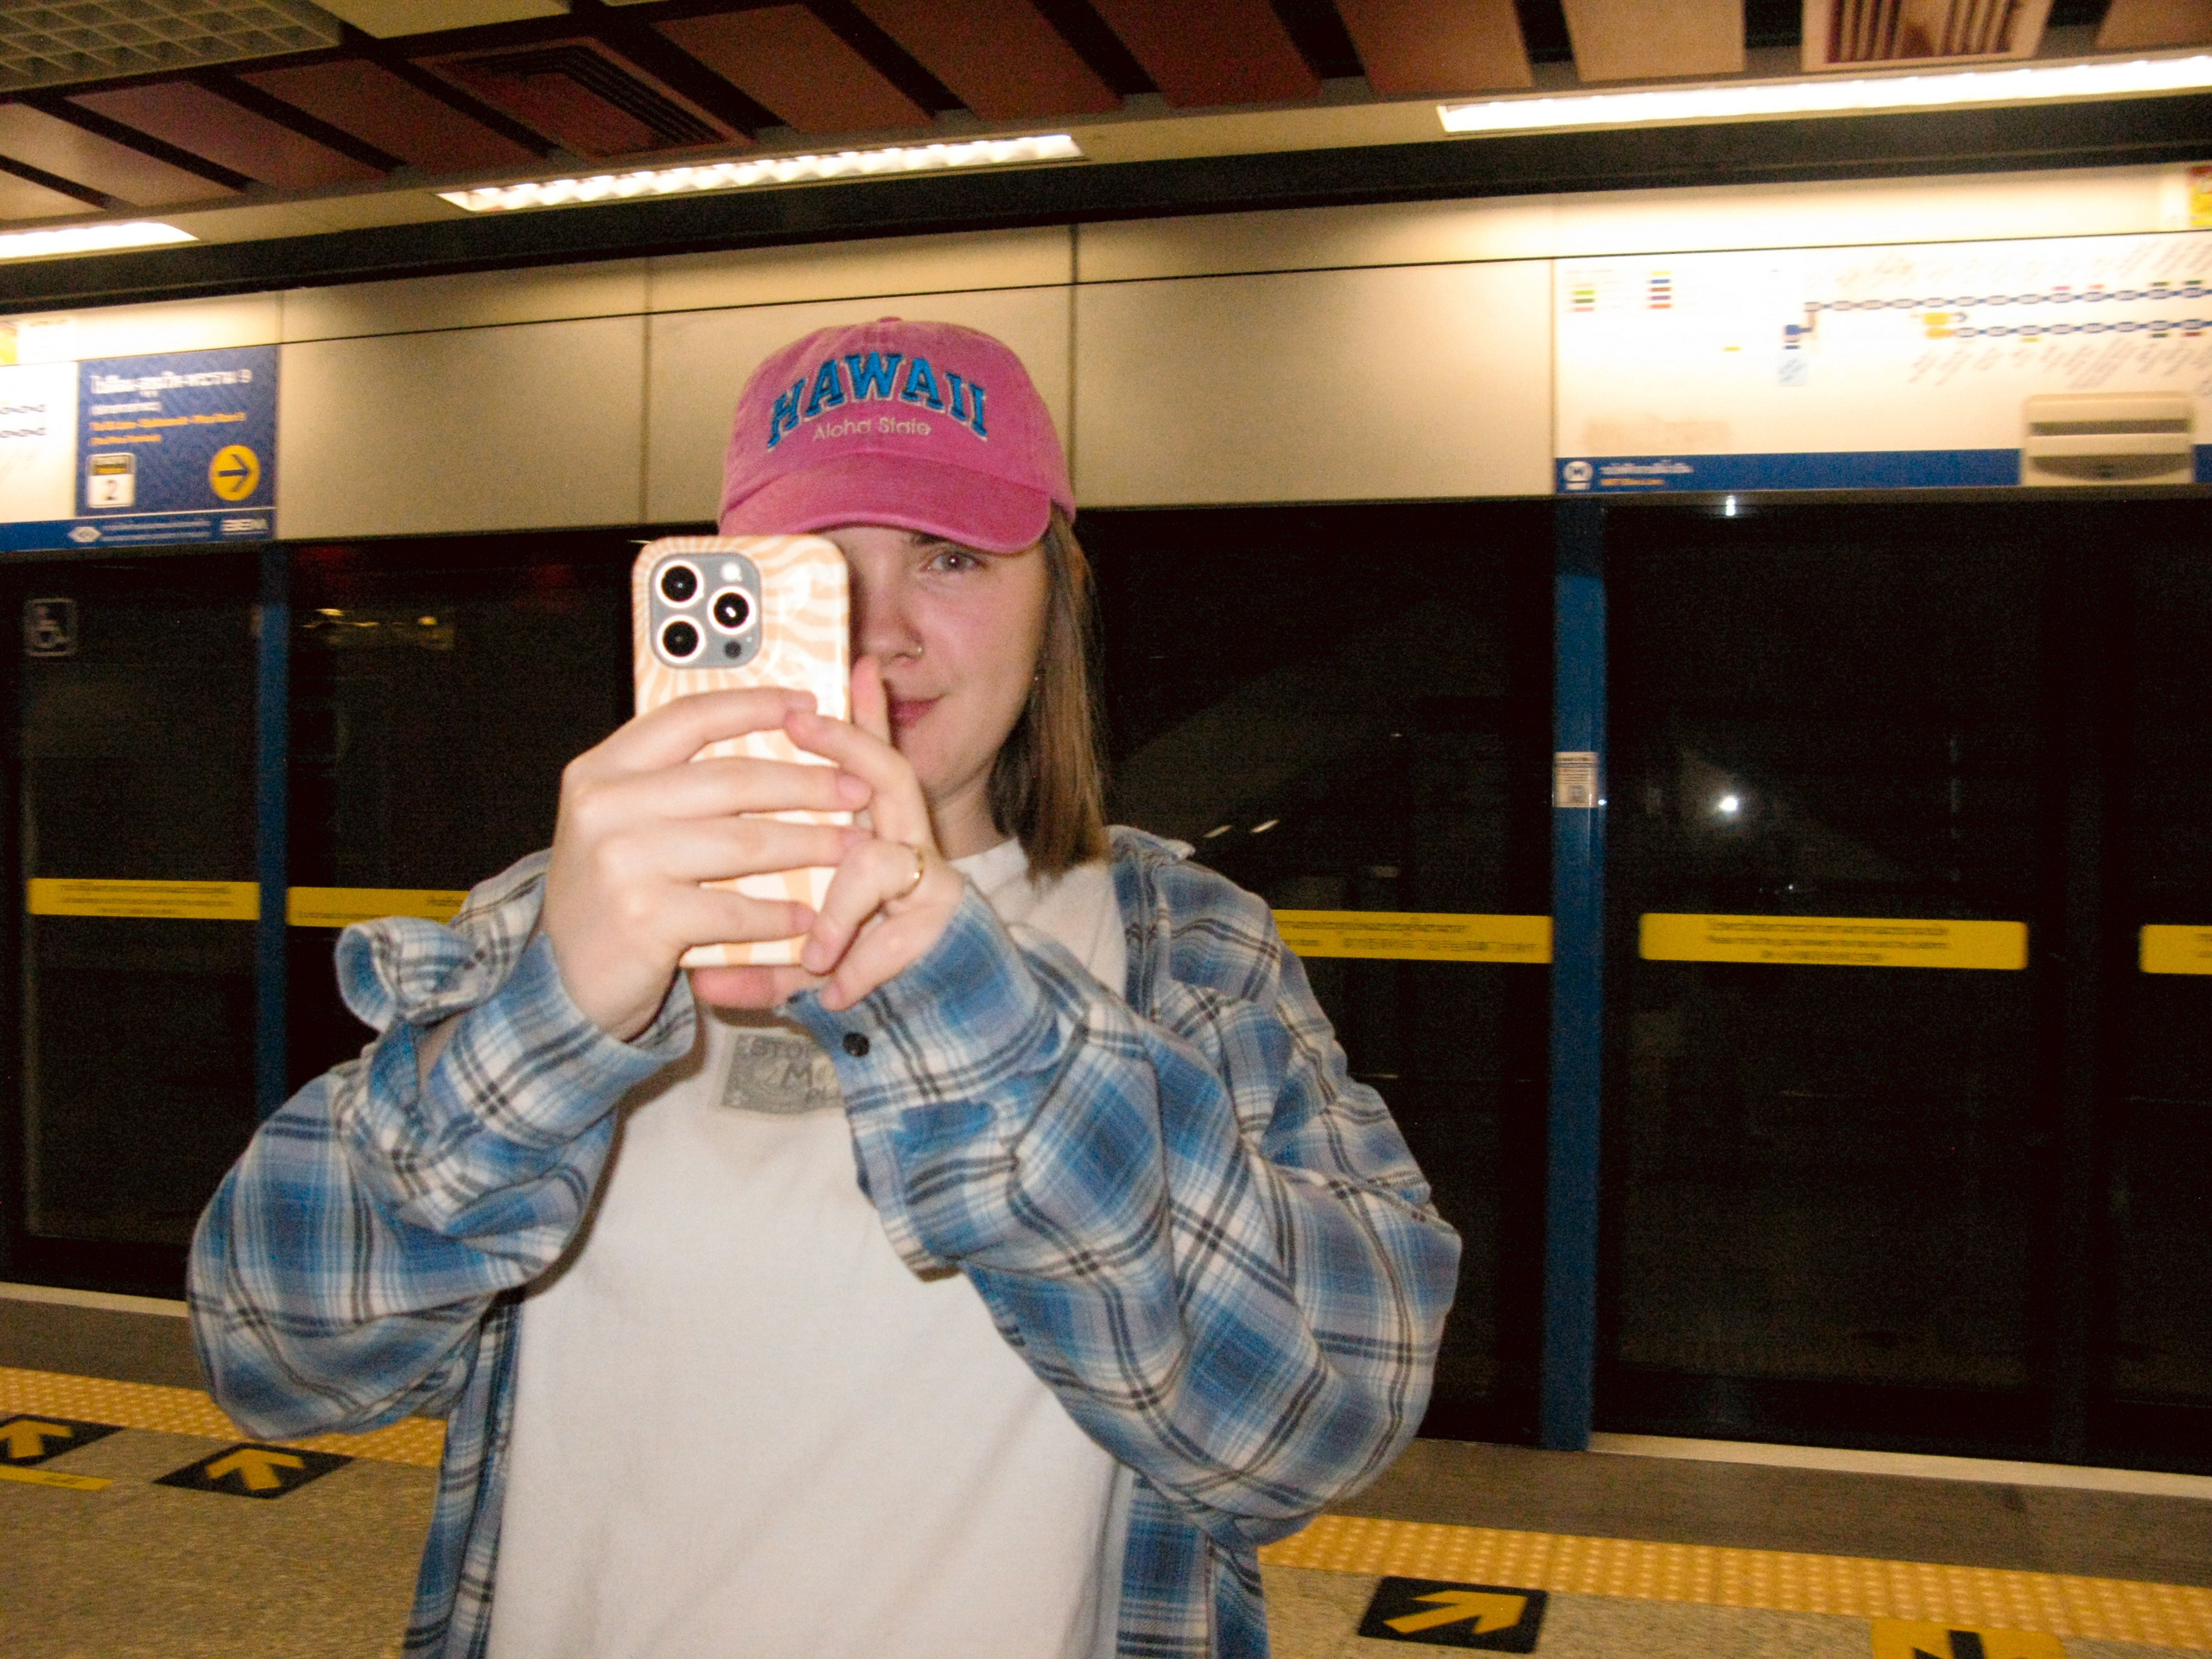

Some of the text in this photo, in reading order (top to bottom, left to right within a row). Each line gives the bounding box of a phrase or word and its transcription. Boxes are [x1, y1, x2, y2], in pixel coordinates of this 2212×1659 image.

[766, 349, 988, 452] HAWAII
[813, 416, 931, 442] Aloha State
